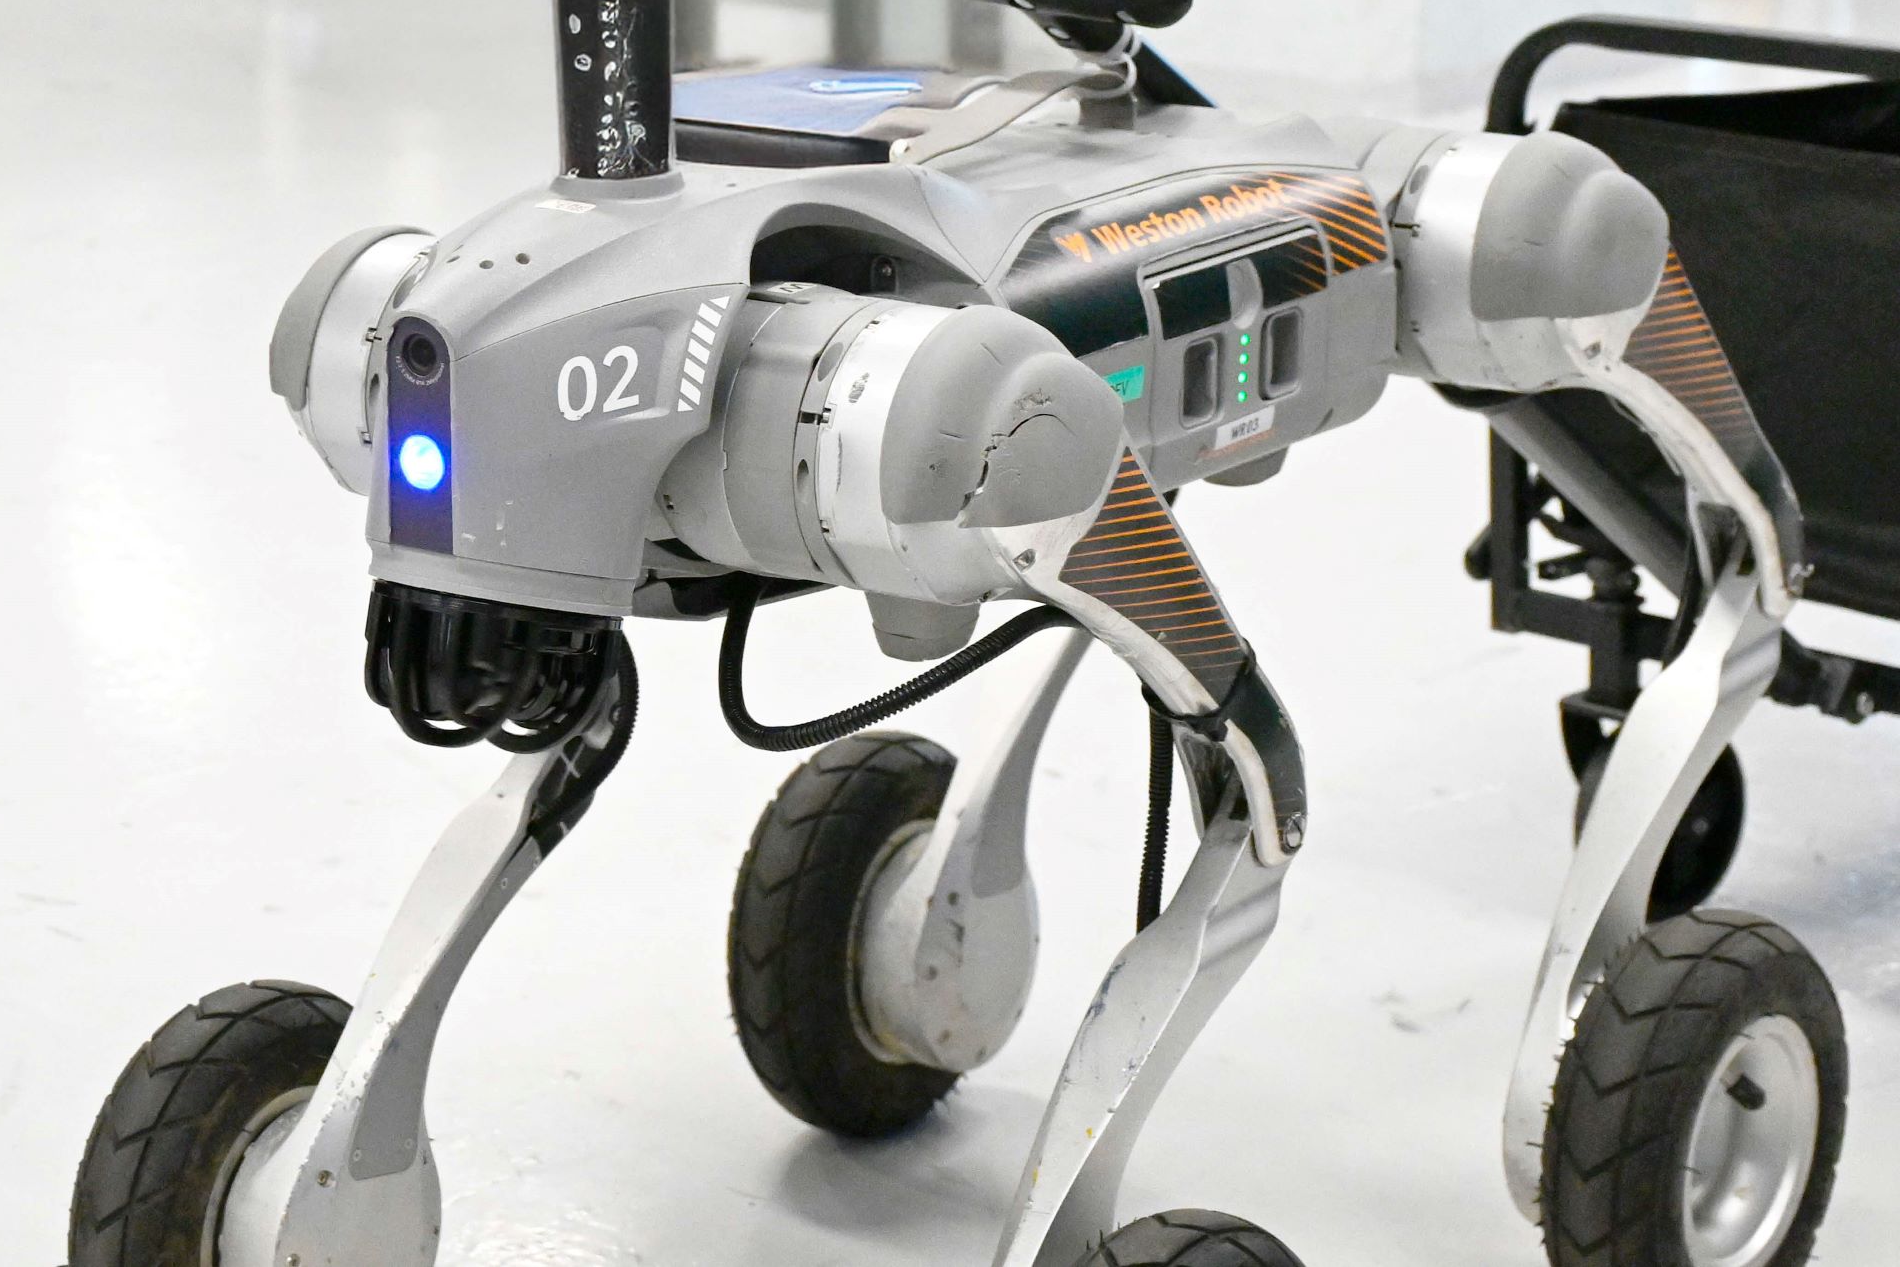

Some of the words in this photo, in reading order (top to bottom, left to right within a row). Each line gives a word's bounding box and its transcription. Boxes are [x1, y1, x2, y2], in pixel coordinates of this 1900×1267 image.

[1091, 206, 1206, 255] Weston
[1199, 178, 1290, 224] Robot
[557, 345, 639, 422] 02
[1231, 417, 1260, 439] WR03
